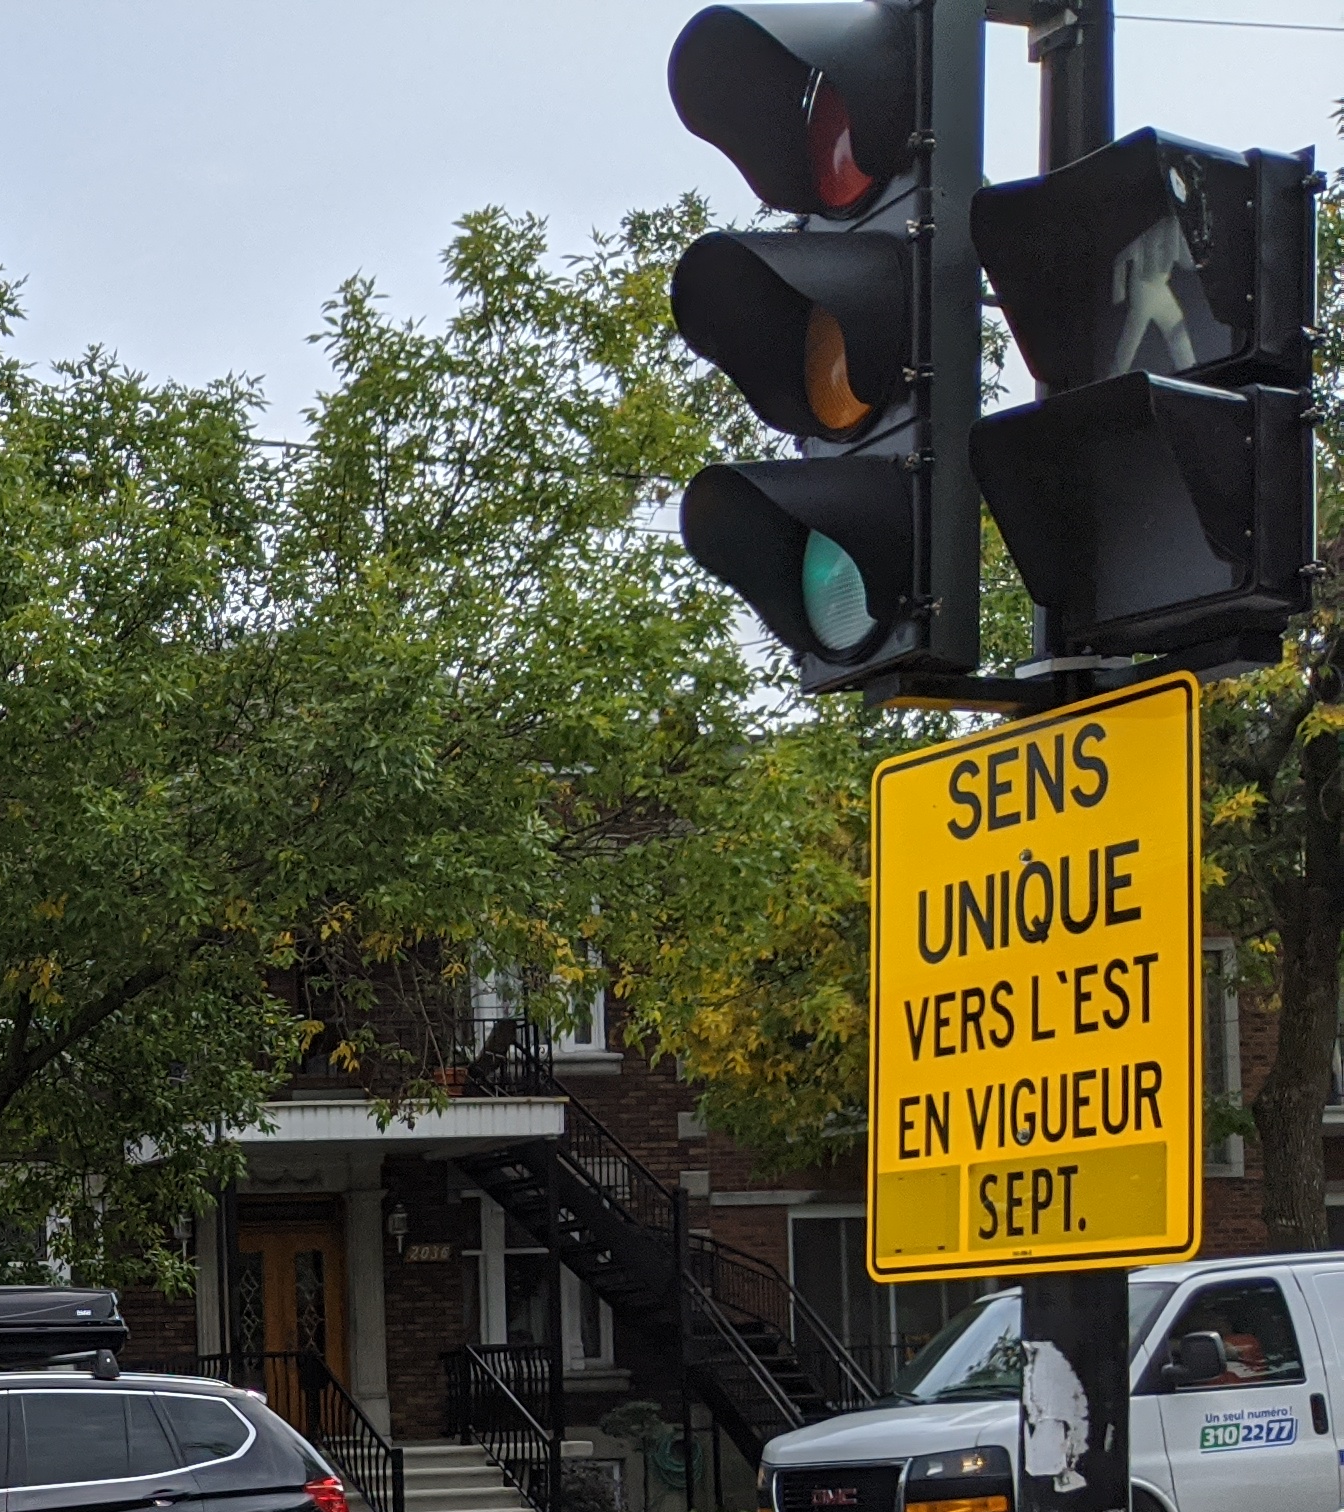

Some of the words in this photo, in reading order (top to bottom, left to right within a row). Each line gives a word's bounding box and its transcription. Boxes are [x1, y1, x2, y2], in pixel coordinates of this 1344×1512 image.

[946, 722, 1109, 840] SENS
[917, 839, 1143, 965] UNIQUE
[903, 980, 1015, 1062] VERS
[1030, 952, 1160, 1042] L'EST
[898, 1091, 951, 1161] EN
[965, 1060, 1164, 1151] VIGUEUR
[978, 1164, 1088, 1242] SEPT.
[1205, 1413, 1220, 1423] Un
[1223, 1409, 1244, 1422] seul
